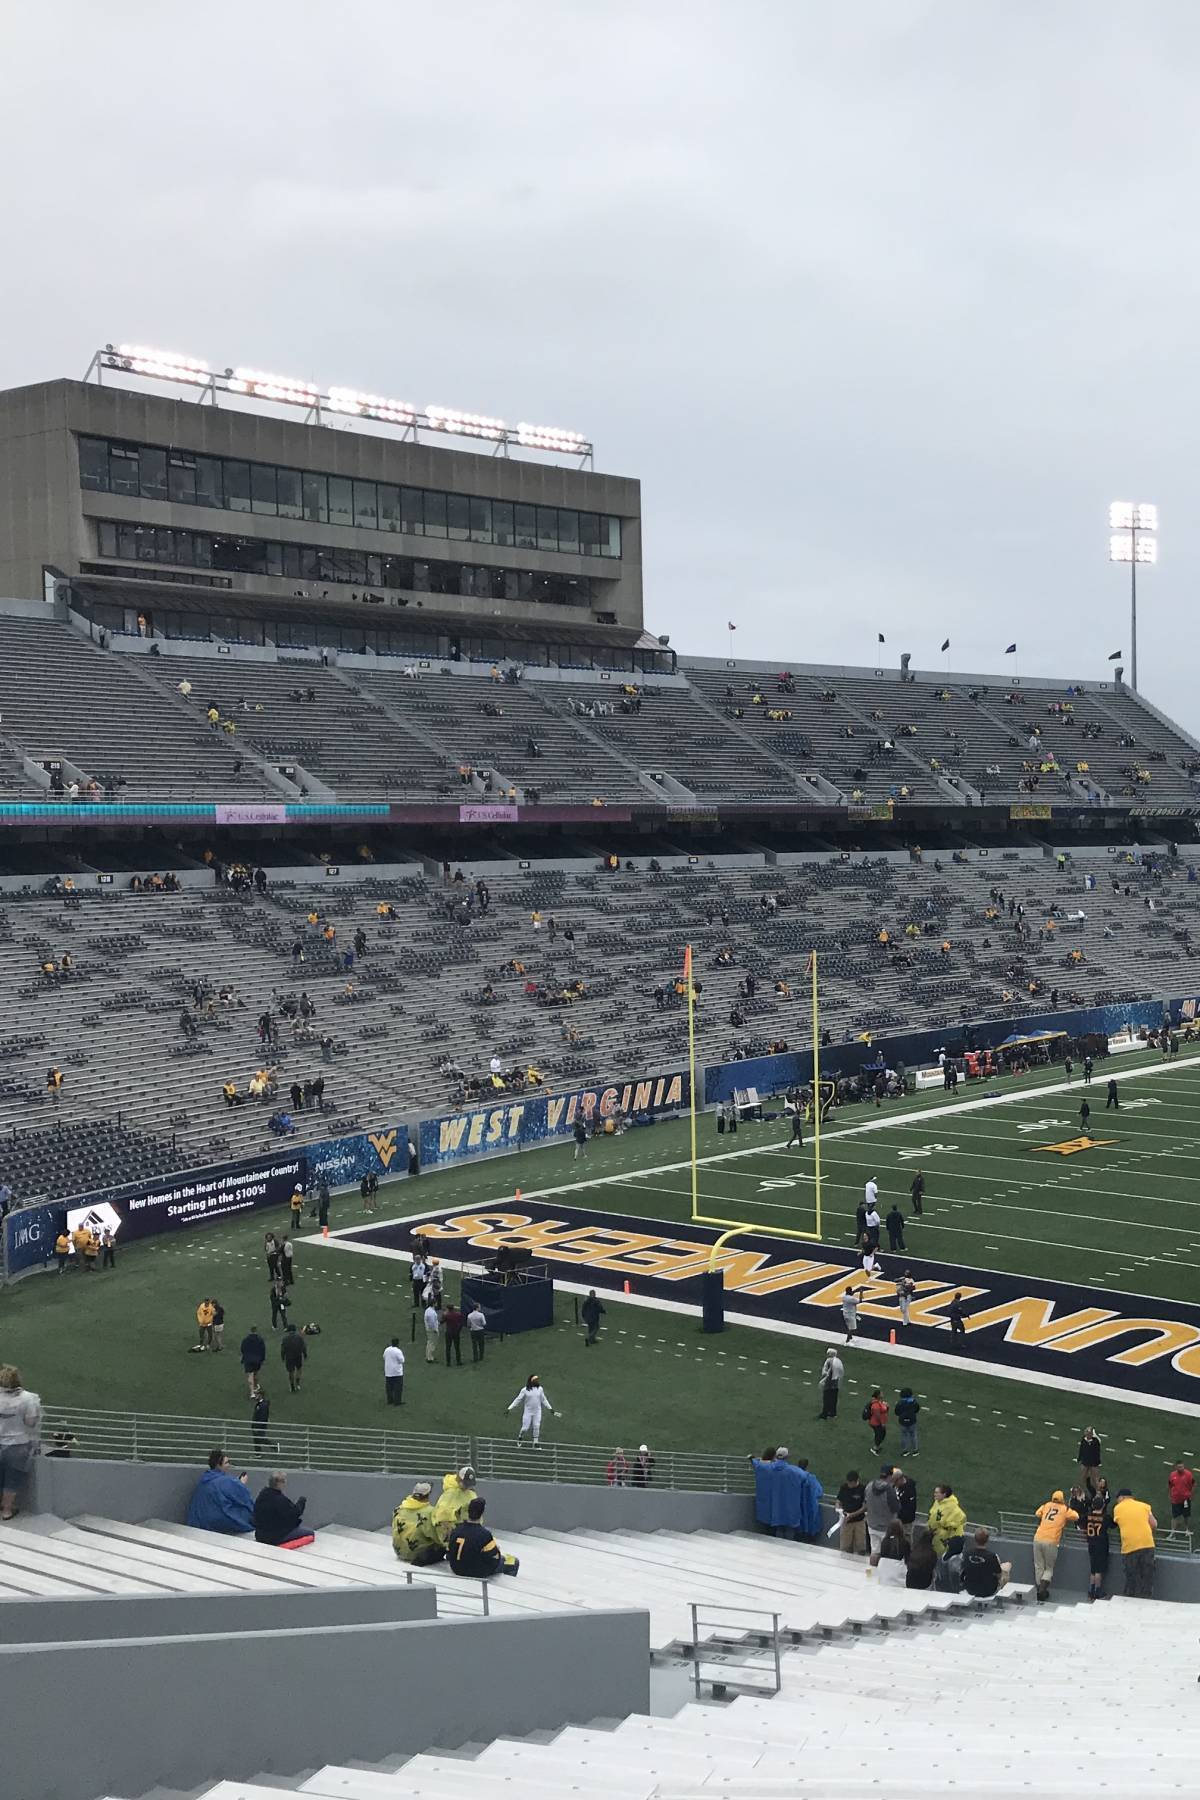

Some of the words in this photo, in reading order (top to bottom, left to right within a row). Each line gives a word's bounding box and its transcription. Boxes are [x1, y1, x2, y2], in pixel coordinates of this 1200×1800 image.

[439, 1105, 524, 1152] WEST
[547, 1075, 682, 1129] VIRGINIA
[315, 1154, 356, 1173] NISSAN
[129, 1198, 146, 1211] New
[147, 1192, 173, 1206] Homes
[174, 1189, 181, 1200] in
[182, 1186, 195, 1198] the
[196, 1180, 217, 1195] Heart
[217, 1178, 226, 1190] of
[226, 1171, 270, 1188] Mountaineer
[270, 1161, 299, 1178] Country!
[167, 1199, 206, 1217] Starting
[207, 1196, 217, 1207] in
[218, 1191, 234, 1204] the
[235, 1184, 266, 1201] $100's!
[14, 1224, 40, 1250] IMG
[1045, 1507, 1059, 1521] 12
[1087, 1522, 1102, 1537] 67
[456, 1537, 465, 1560] 7
